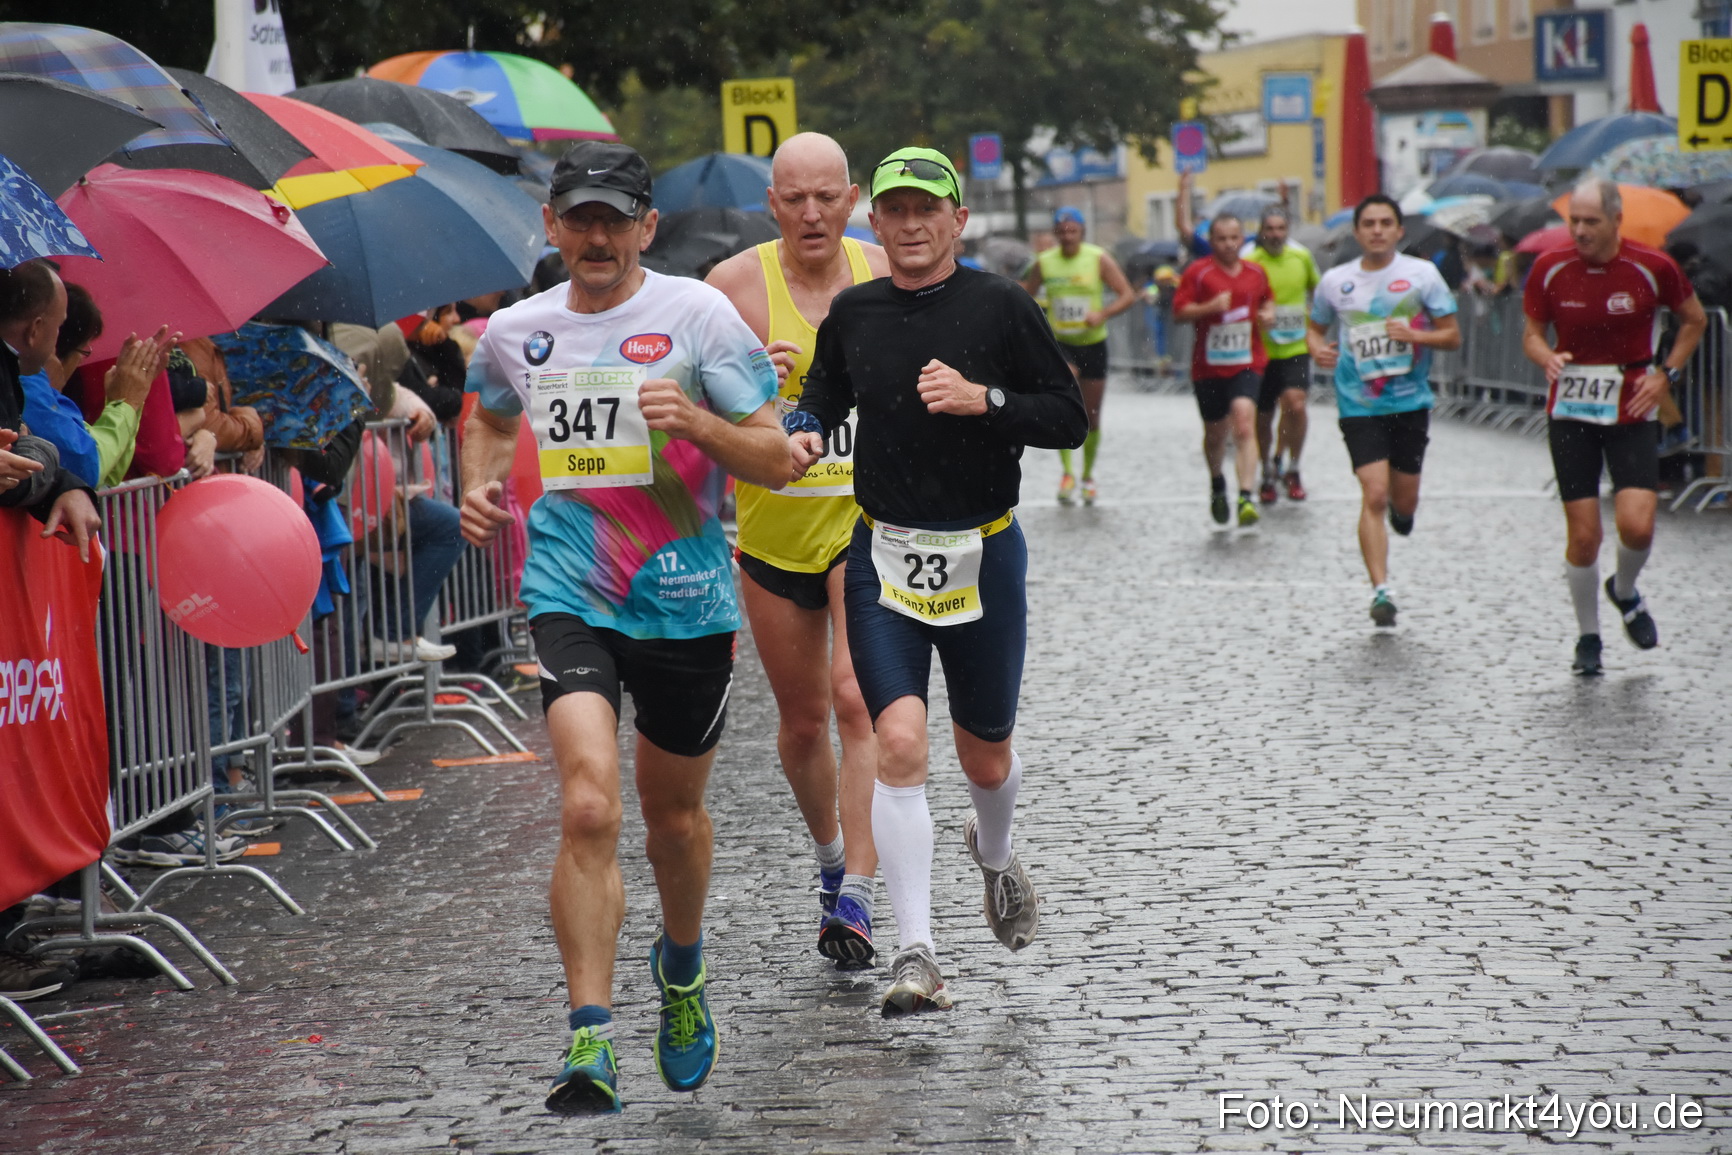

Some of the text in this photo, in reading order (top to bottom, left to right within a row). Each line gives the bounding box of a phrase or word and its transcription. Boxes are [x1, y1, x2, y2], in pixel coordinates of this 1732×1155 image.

[1544, 17, 1599, 69] KL
[1688, 43, 1732, 64] Bloc
[732, 85, 786, 105] Block
[1698, 73, 1731, 126] D
[744, 114, 778, 156] D
[627, 340, 667, 357] Hervis
[751, 361, 773, 373] Neue
[537, 382, 568, 391] NeuerMarkt
[575, 372, 634, 386] BOCK
[1563, 376, 1616, 401] 2747
[548, 397, 620, 443] 347
[567, 454, 606, 475] Sepp
[802, 462, 854, 478] ens-Peter
[916, 533, 971, 548] BOCK
[656, 551, 686, 573] 17.
[903, 553, 949, 591] 23
[659, 568, 718, 586] Neumarkte
[658, 583, 711, 599] Stadtlauf
[892, 588, 966, 616] Franz Xaver
